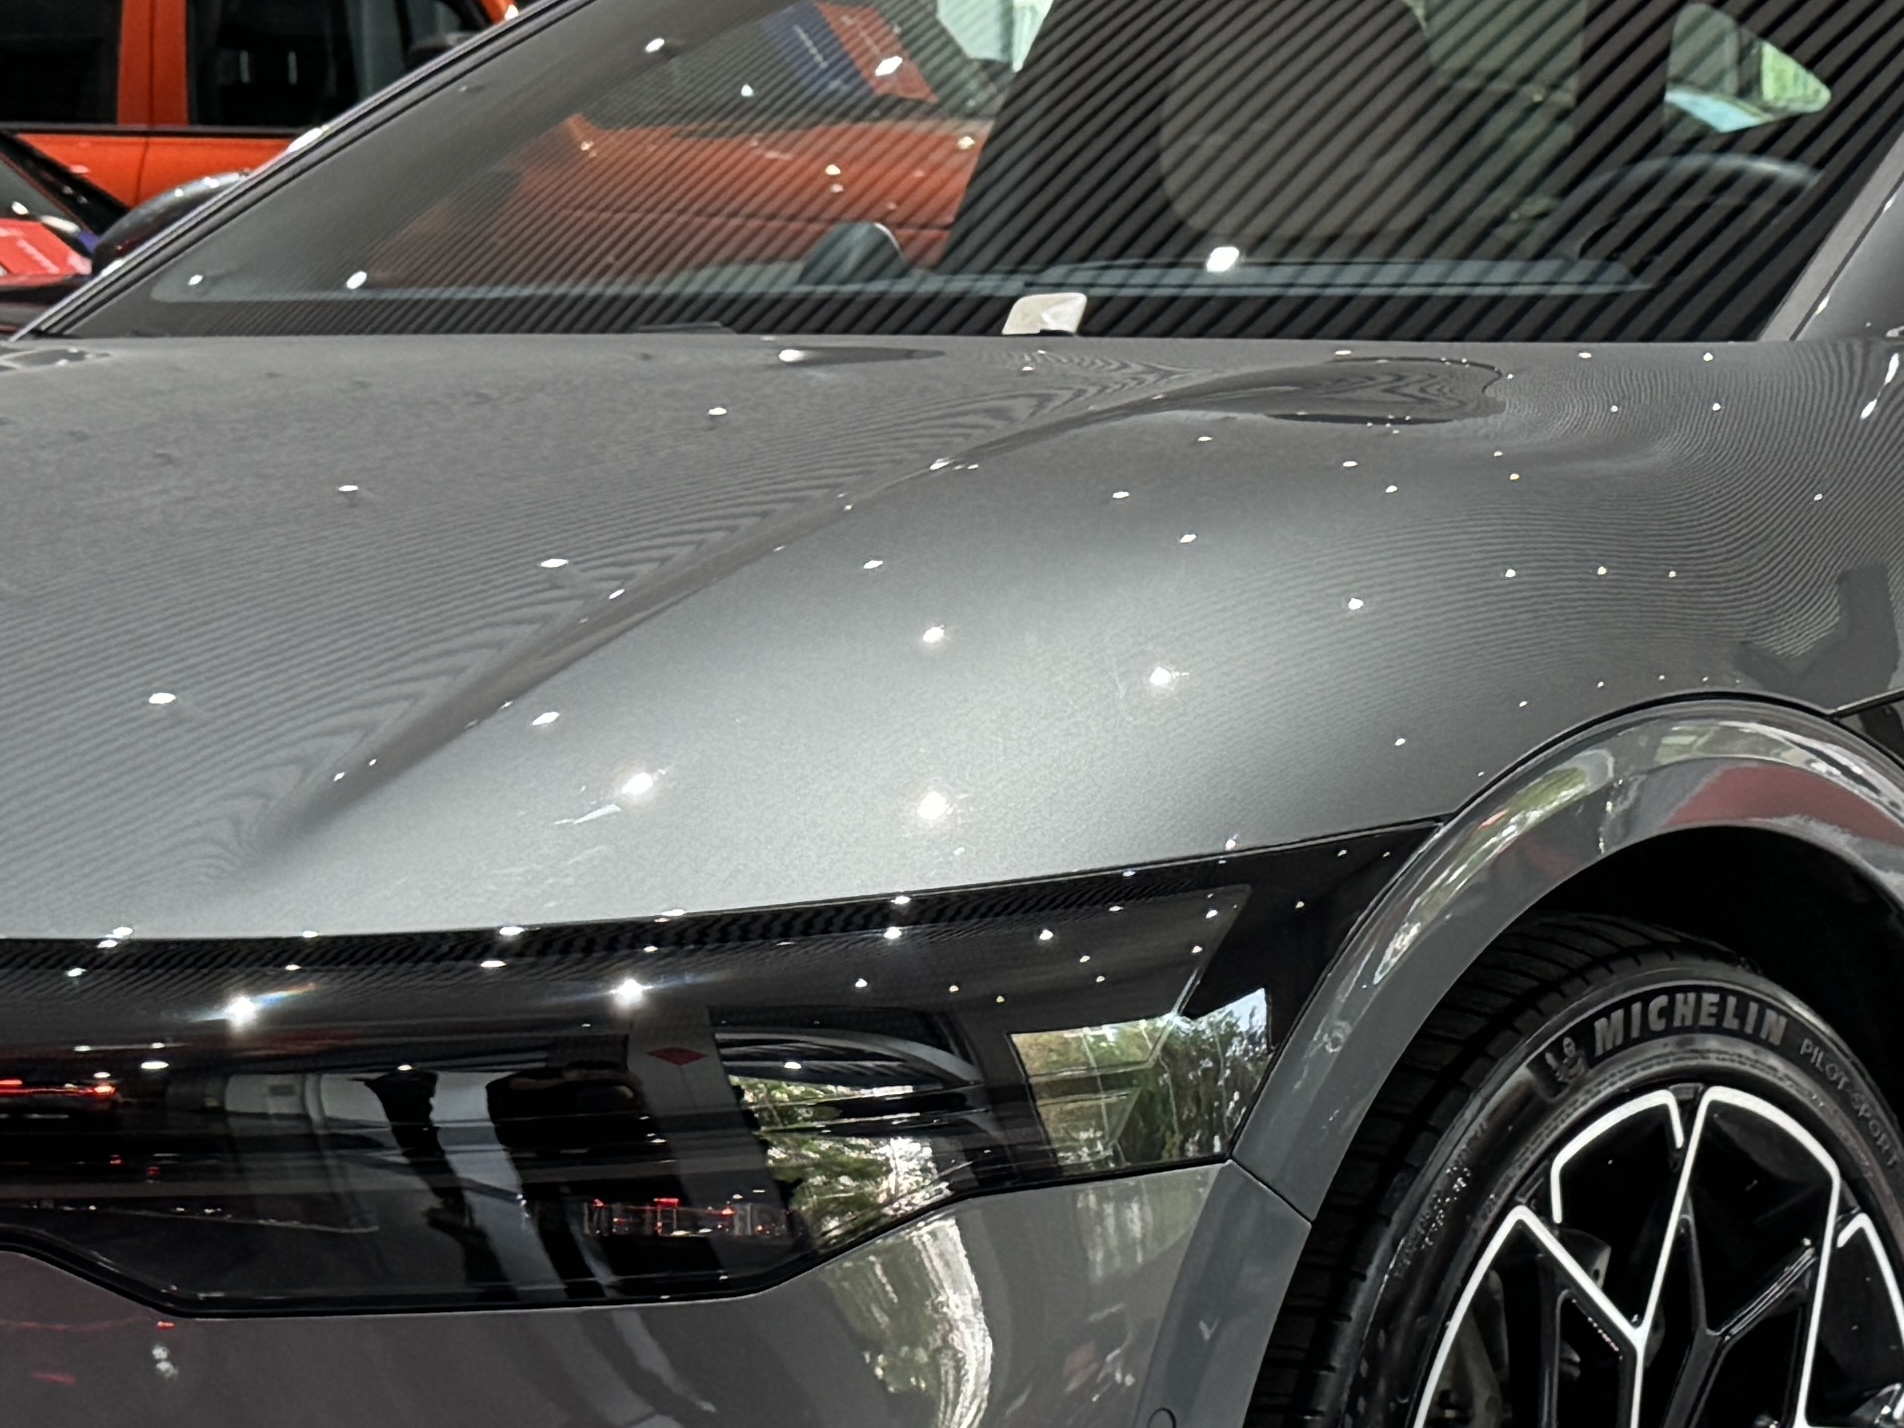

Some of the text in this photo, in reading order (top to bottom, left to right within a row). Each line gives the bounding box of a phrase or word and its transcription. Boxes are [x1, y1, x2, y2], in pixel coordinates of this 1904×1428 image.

[1594, 992, 1898, 1166] MICHELIN PILOT SPORT
